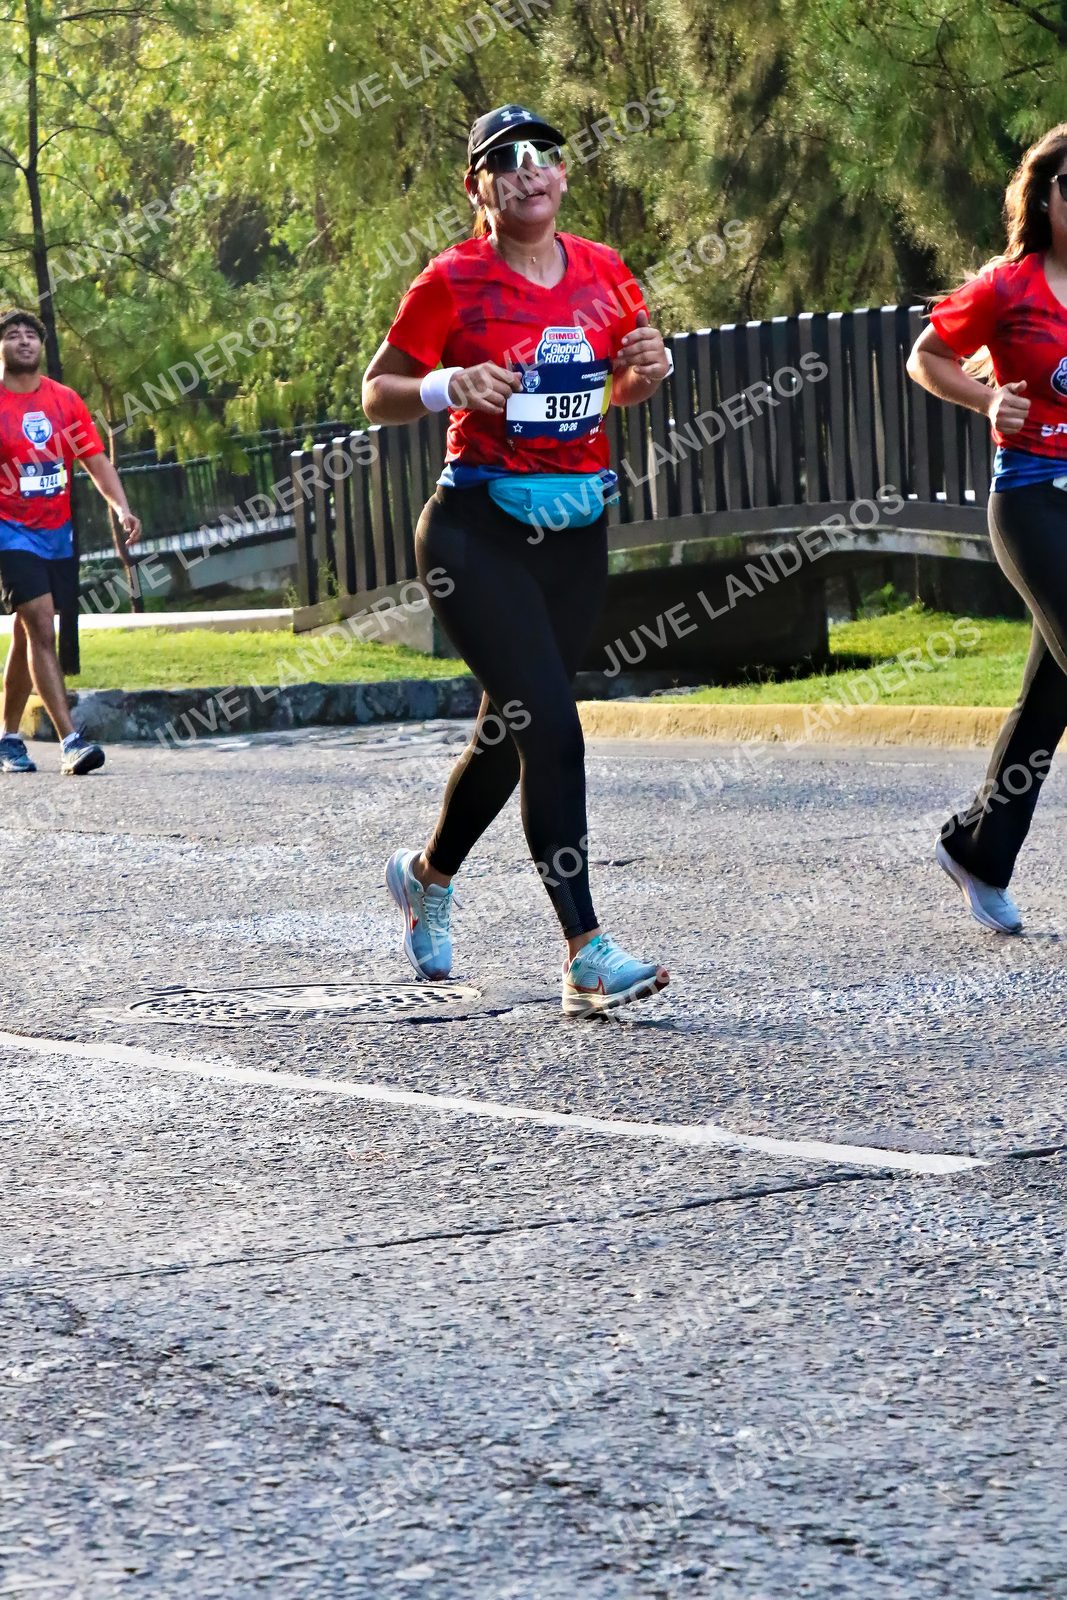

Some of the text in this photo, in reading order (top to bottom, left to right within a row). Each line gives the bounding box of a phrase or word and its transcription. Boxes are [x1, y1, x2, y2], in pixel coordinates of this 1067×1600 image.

[549, 332, 580, 340] BIMBO
[550, 343, 580, 354] Global
[545, 353, 570, 363] Race
[545, 393, 591, 419] 3927
